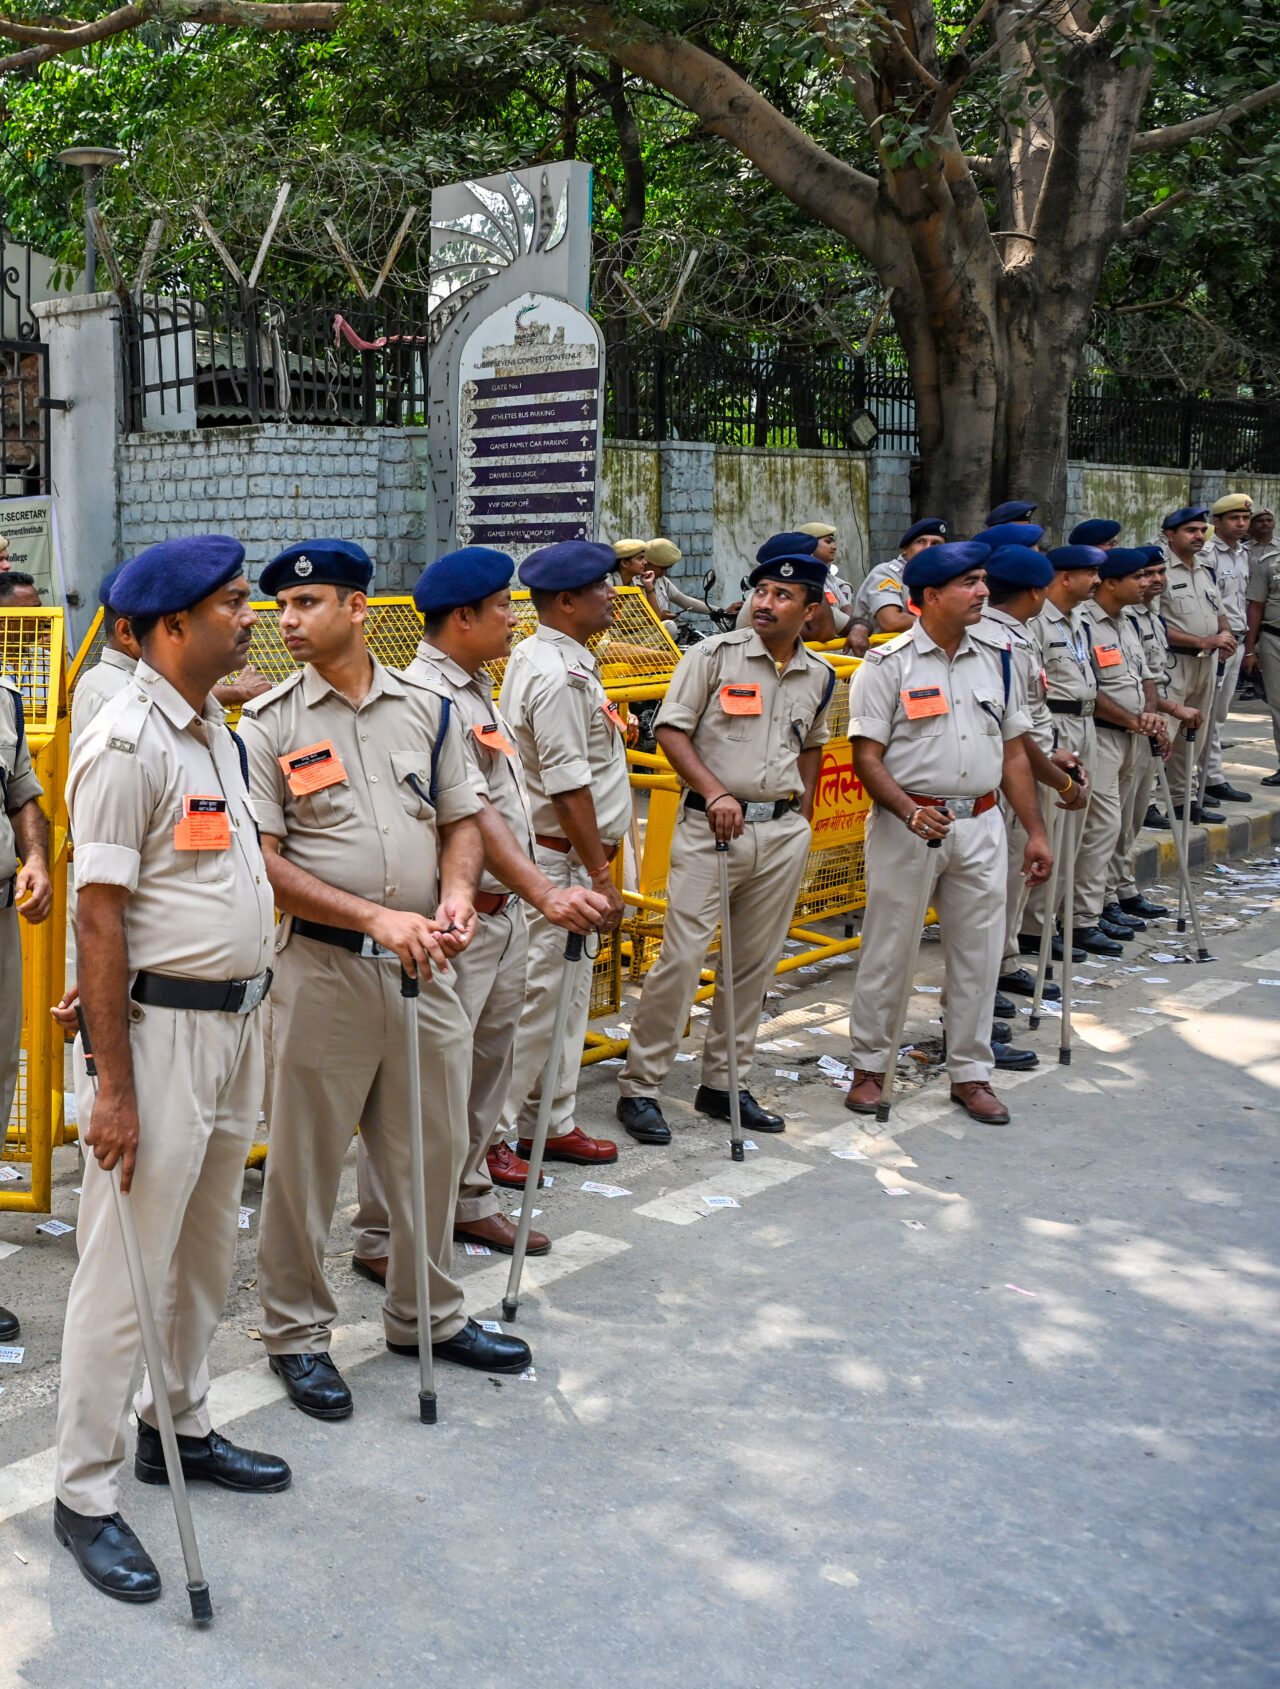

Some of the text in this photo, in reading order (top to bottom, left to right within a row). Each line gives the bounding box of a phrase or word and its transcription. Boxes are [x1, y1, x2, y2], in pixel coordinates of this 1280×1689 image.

[473, 360, 494, 369] RUGBY
[517, 355, 561, 365] COMPETITION
[561, 351, 582, 360] VENUE
[490, 412, 517, 420] ATHLETES
[530, 409, 556, 417] PARKING
[490, 438, 569, 450] GAMES FAMILY CAR PARKING
[517, 499, 529, 507] OFF
[526, 529, 543, 537] DROP
[9, 552, 28, 563] ollege
